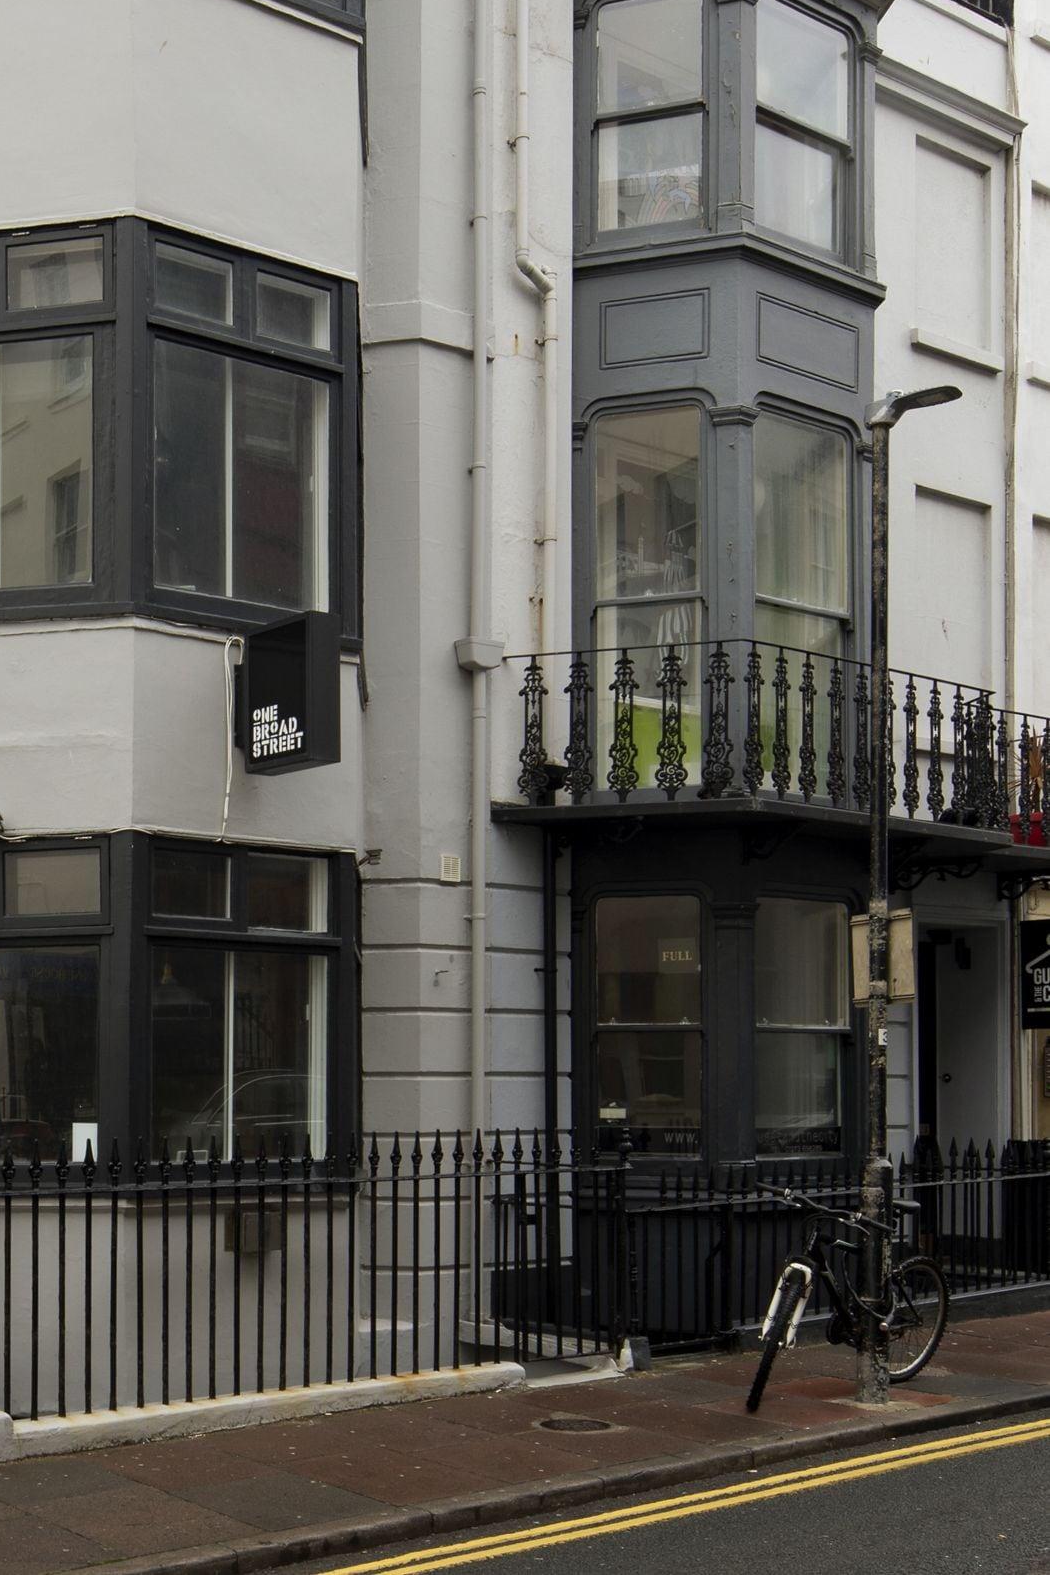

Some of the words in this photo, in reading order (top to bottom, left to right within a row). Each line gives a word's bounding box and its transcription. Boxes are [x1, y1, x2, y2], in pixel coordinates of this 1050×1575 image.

[253, 704, 278, 724] ONE
[253, 716, 298, 742] BROAD
[253, 731, 304, 758] STREET
[661, 950, 693, 962] FULL
